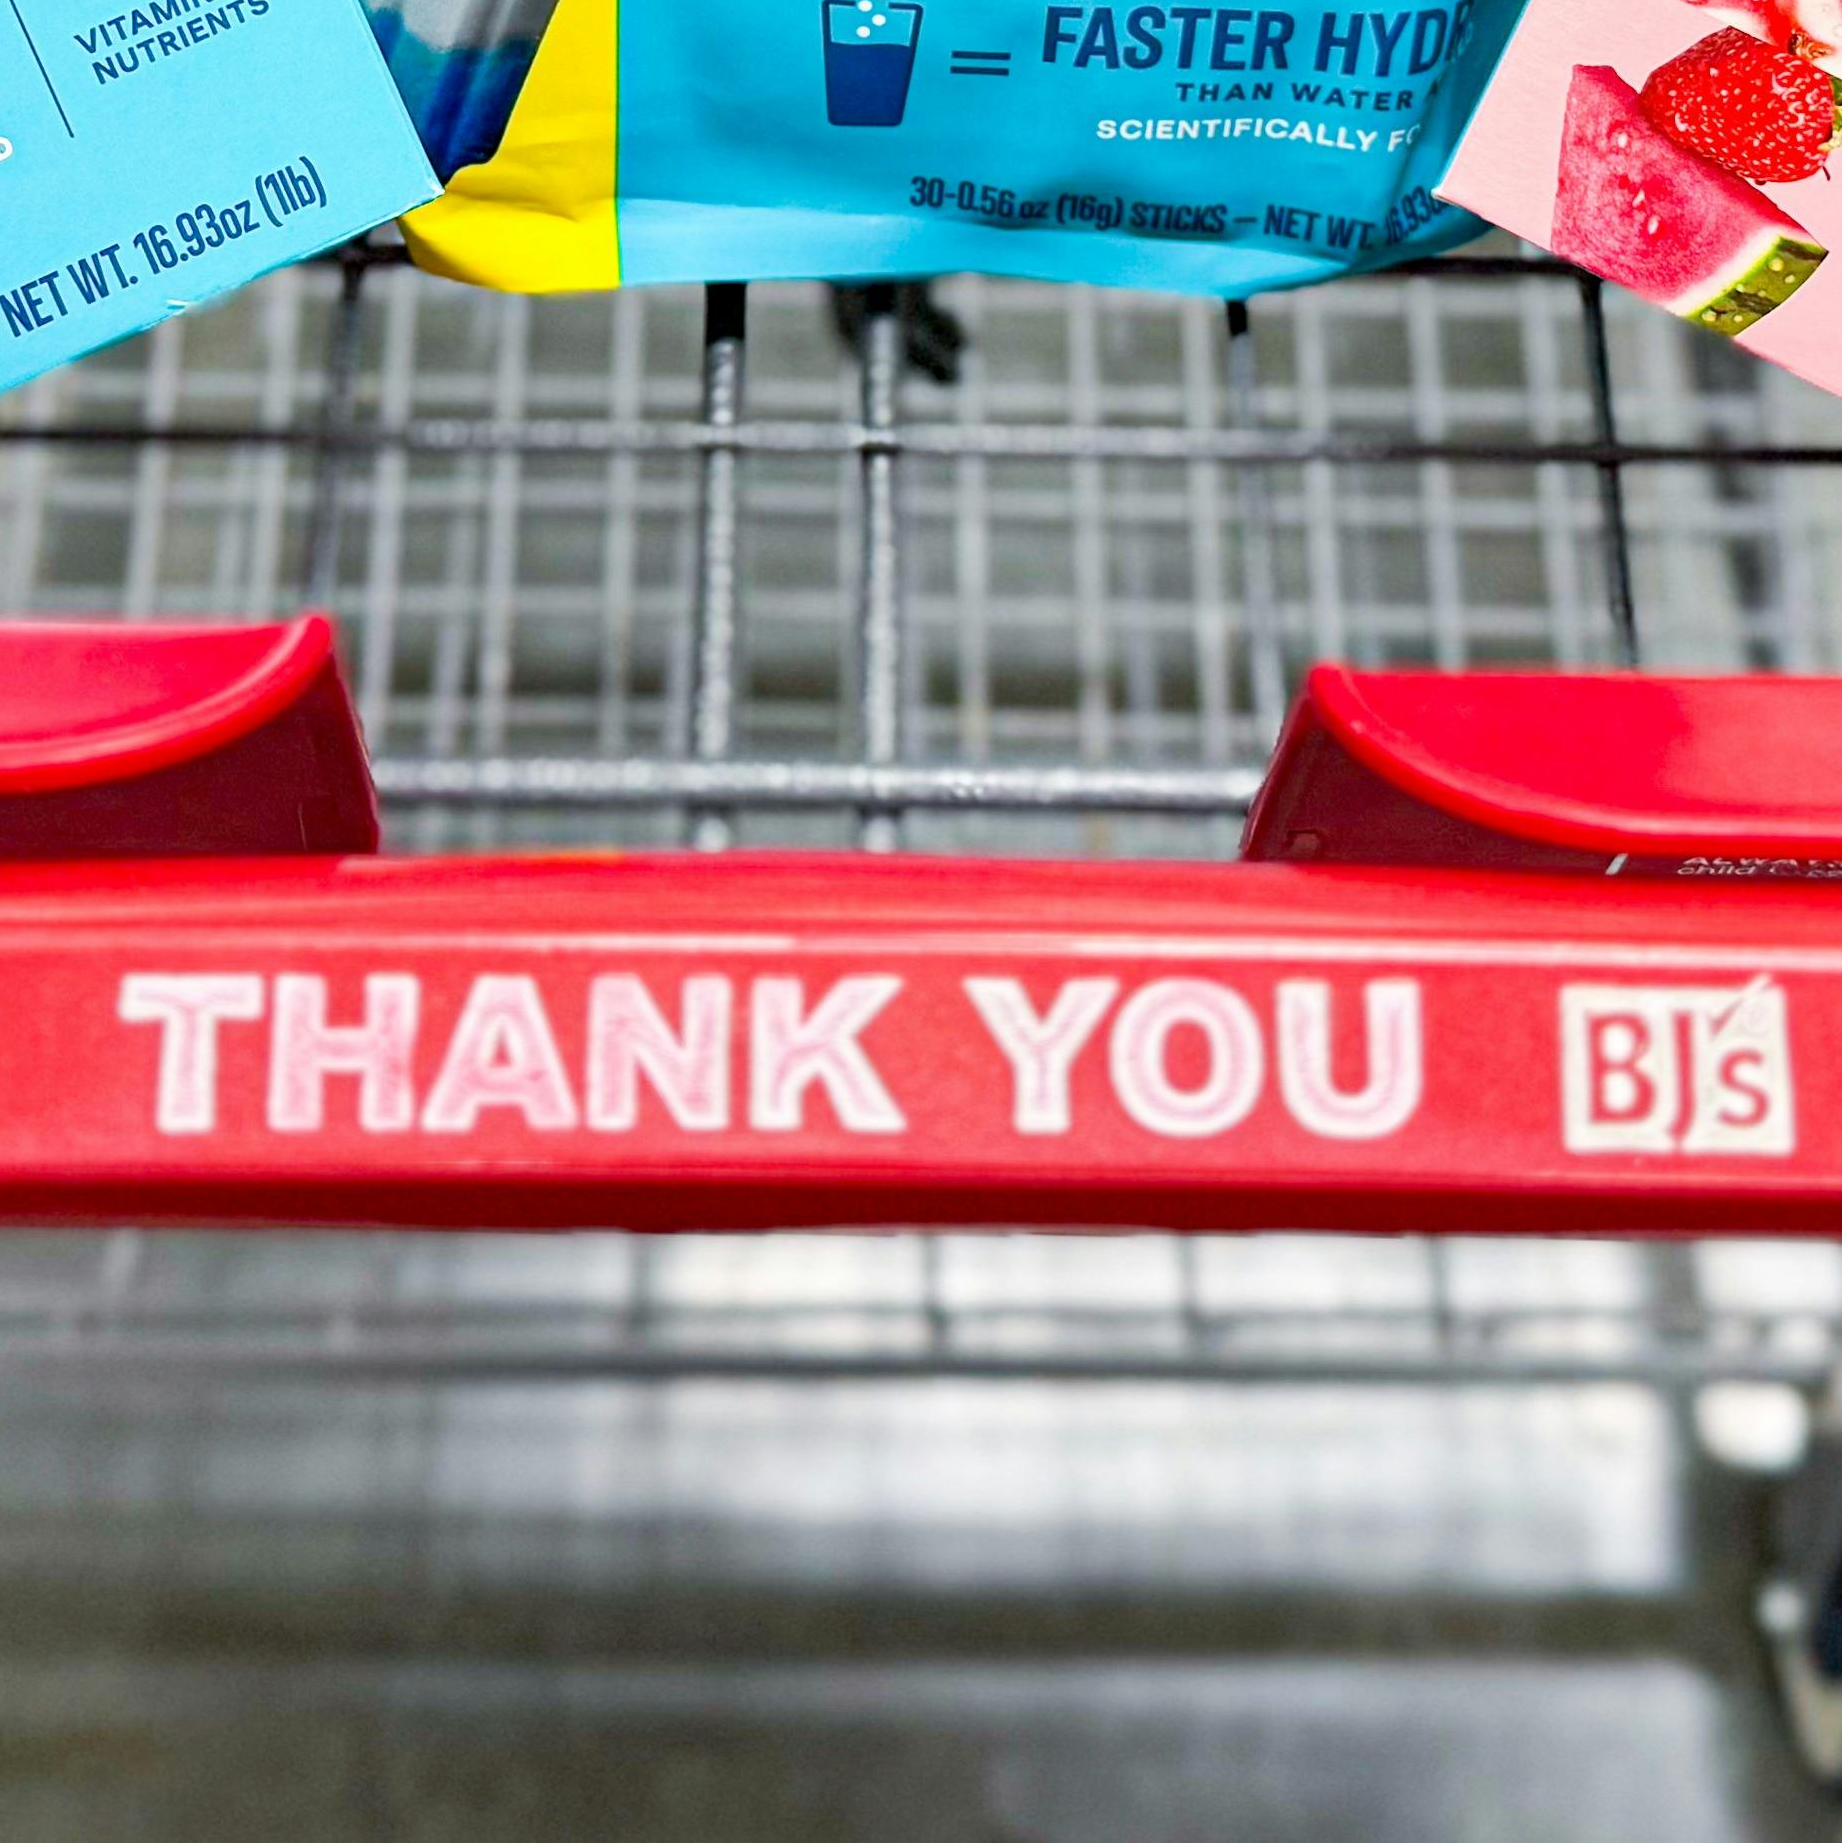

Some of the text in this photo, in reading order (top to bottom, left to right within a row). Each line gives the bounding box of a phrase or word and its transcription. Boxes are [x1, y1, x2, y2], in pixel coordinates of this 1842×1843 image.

[1042, 5, 1295, 72] FASTER
[1176, 81, 1274, 103] THAN
[1291, 83, 1414, 113] WATER
[1096, 118, 1379, 153] SCIENTIFICALLY
[70, 243, 140, 308] WT.
[133, 200, 260, 275] 16.93oz
[254, 156, 327, 227] (1lb)
[1057, 195, 1125, 233] (16g)
[1130, 201, 1228, 235] STICKS
[1264, 204, 1324, 242] NET
[1326, 215, 1376, 252] WT.
[117, 972, 907, 1135] THANK
[961, 975, 1424, 1139] YOU
